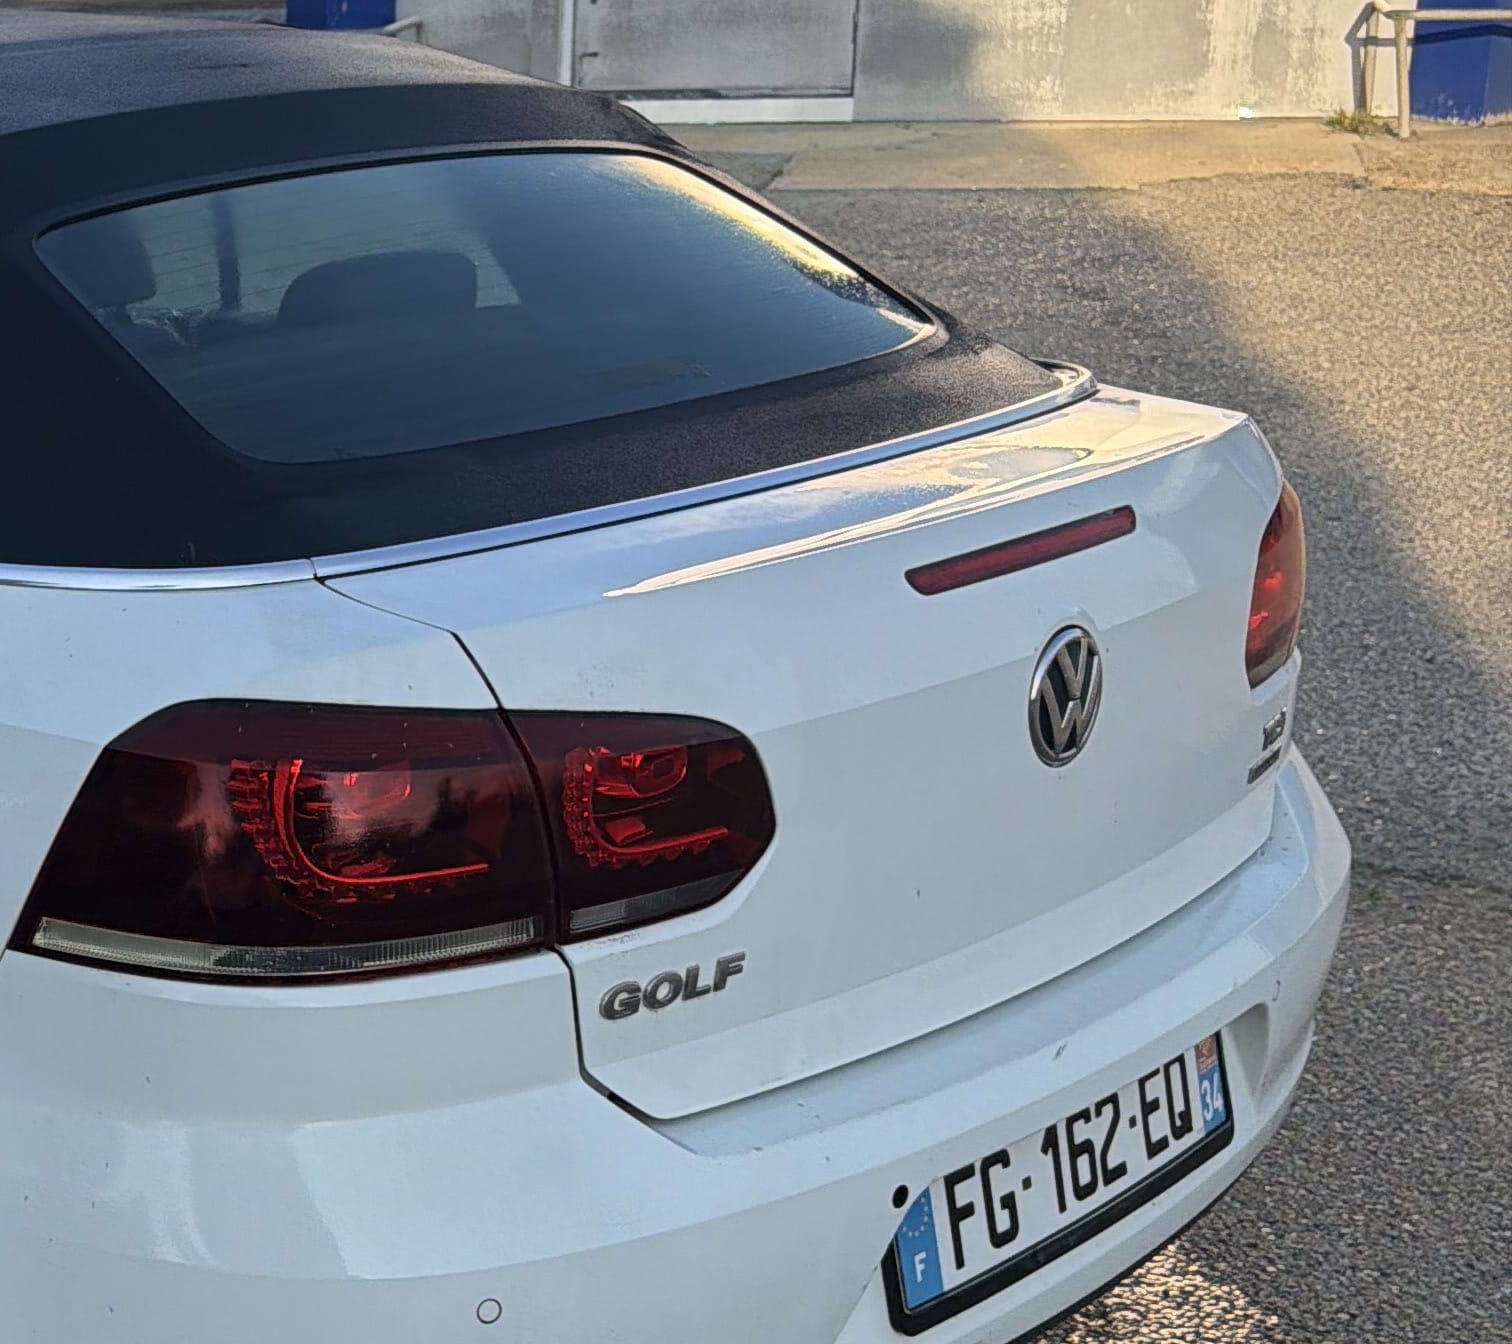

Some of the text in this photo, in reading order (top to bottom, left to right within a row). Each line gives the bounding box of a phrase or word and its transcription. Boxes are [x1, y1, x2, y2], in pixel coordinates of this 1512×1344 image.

[599, 951, 746, 1020] GOLF
[1201, 1071, 1224, 1121] 34
[913, 1251, 928, 1283] F
